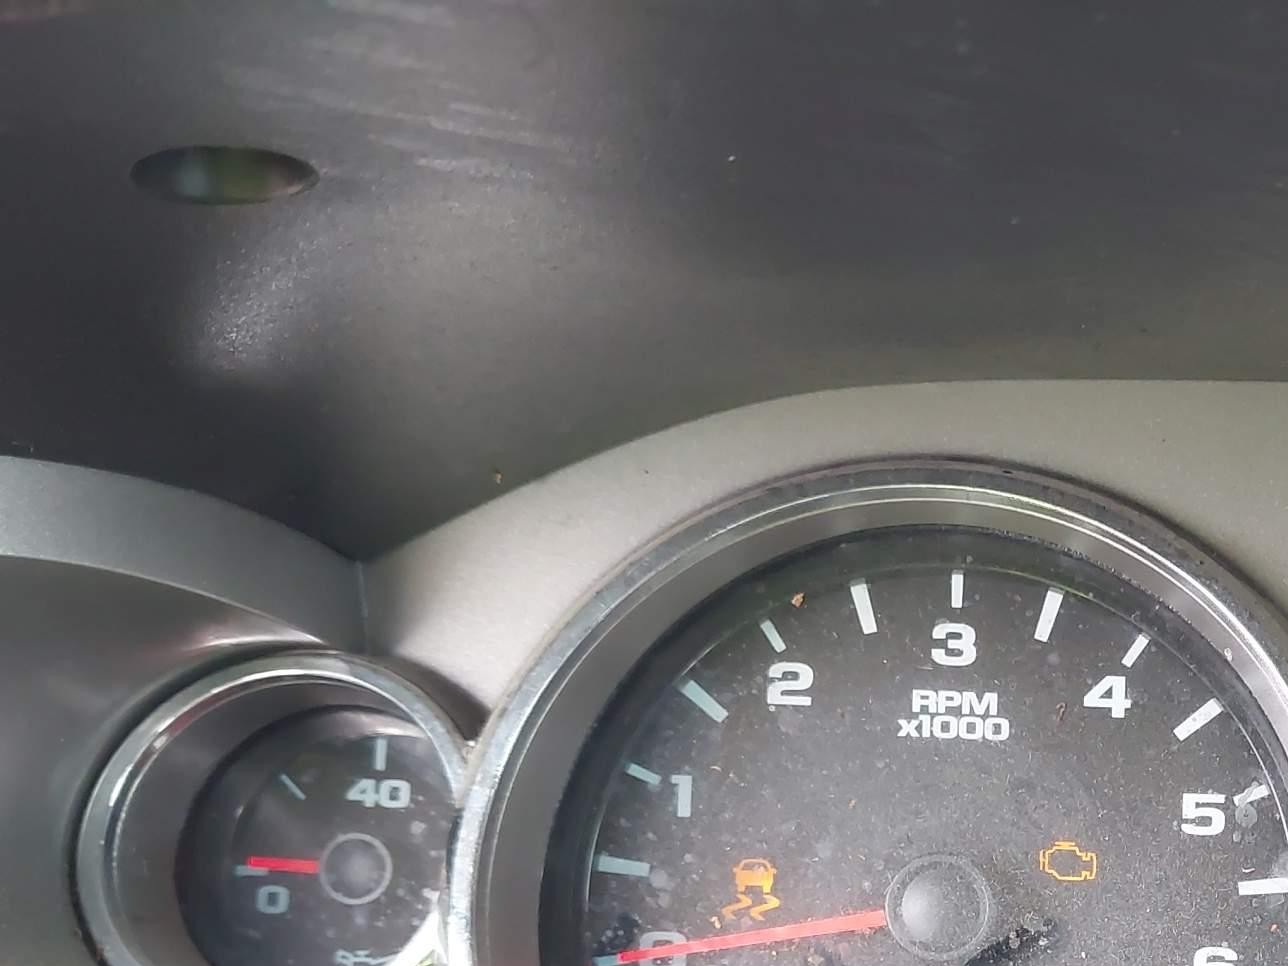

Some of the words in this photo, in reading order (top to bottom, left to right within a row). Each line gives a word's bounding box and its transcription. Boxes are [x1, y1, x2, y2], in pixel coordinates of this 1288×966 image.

[930, 622, 977, 667] 3
[766, 661, 814, 707] 2
[911, 688, 999, 716] RPM
[1083, 675, 1131, 719] 4
[896, 714, 1010, 741] x1000
[345, 778, 412, 809] 40
[671, 774, 693, 818] 1
[1180, 792, 1226, 837] 5
[255, 884, 290, 915] 0
